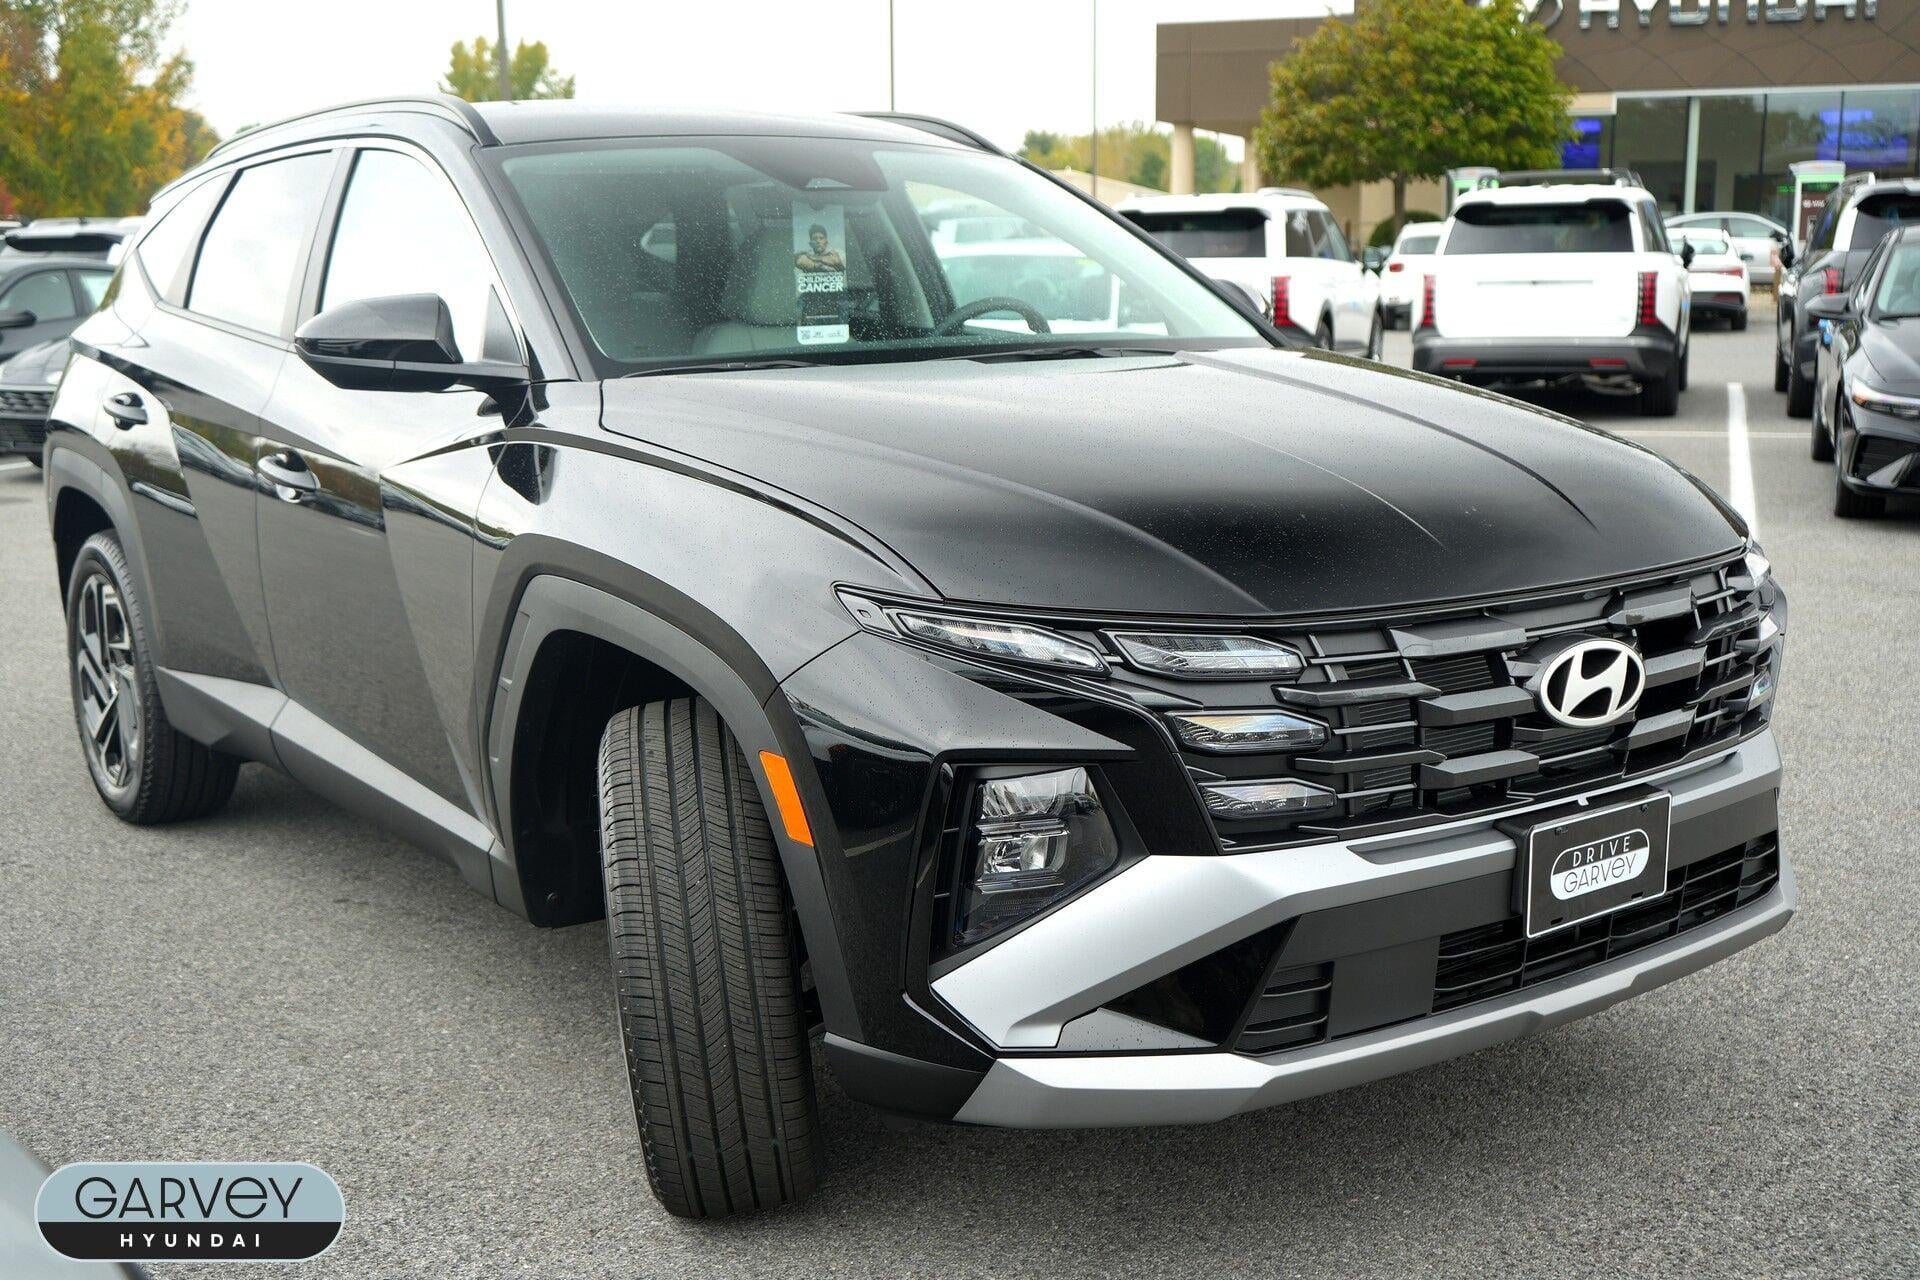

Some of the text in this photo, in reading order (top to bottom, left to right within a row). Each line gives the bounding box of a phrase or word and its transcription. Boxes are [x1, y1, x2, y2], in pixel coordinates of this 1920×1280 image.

[798, 276, 844, 284] CHILDHOOD
[798, 283, 844, 292] CANCER
[1572, 836, 1631, 868] DRIVE
